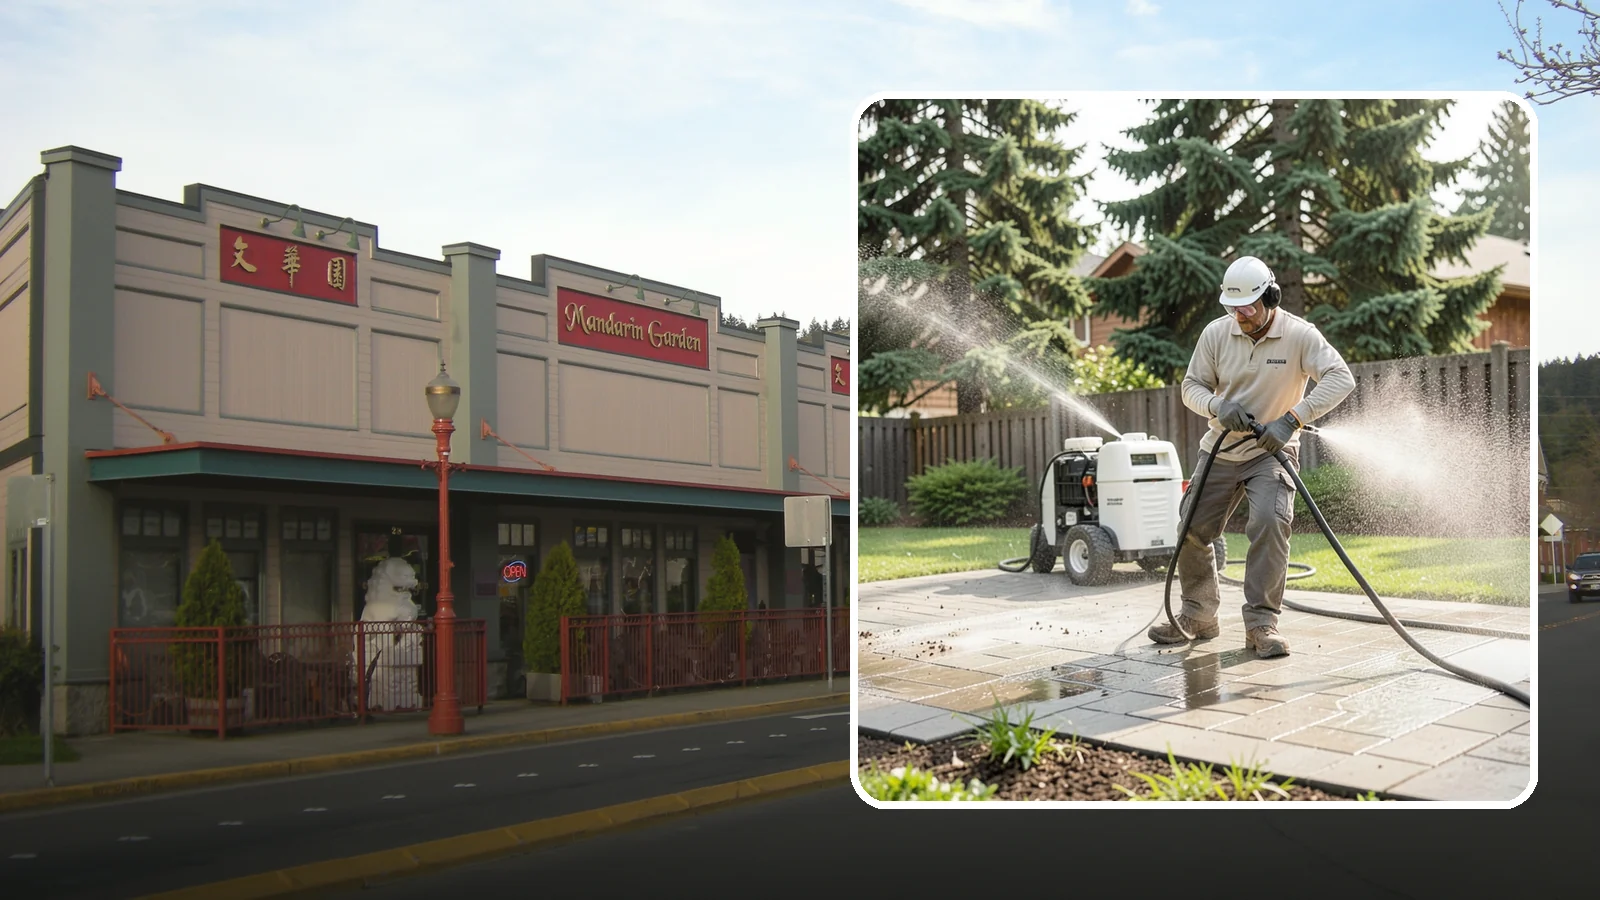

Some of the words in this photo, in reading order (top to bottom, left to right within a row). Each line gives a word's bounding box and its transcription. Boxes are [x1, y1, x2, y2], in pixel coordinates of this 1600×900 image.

[230, 235, 346, 291] 文華園
[564, 302, 645, 341] Mandarin
[647, 320, 702, 352] Garden
[503, 565, 527, 578] OPEN
